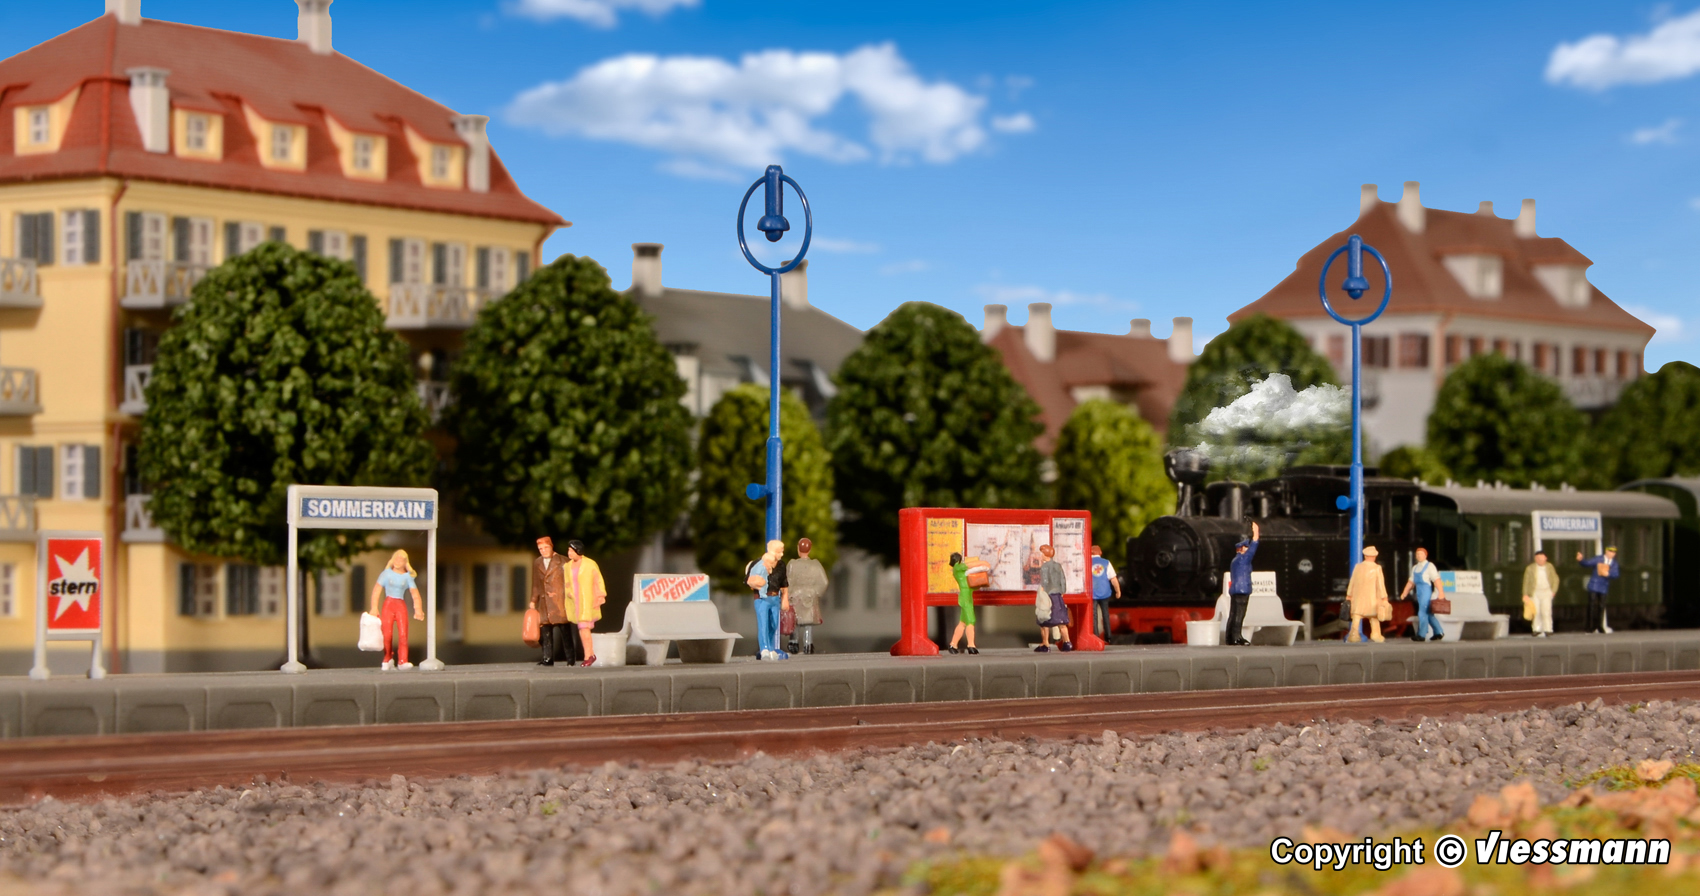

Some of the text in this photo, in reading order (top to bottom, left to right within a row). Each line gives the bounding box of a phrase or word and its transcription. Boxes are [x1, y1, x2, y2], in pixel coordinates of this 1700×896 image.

[308, 500, 426, 518] SOMMERRAIN
[1543, 517, 1595, 530] SOMMERRAIN
[50, 579, 97, 595] stern
